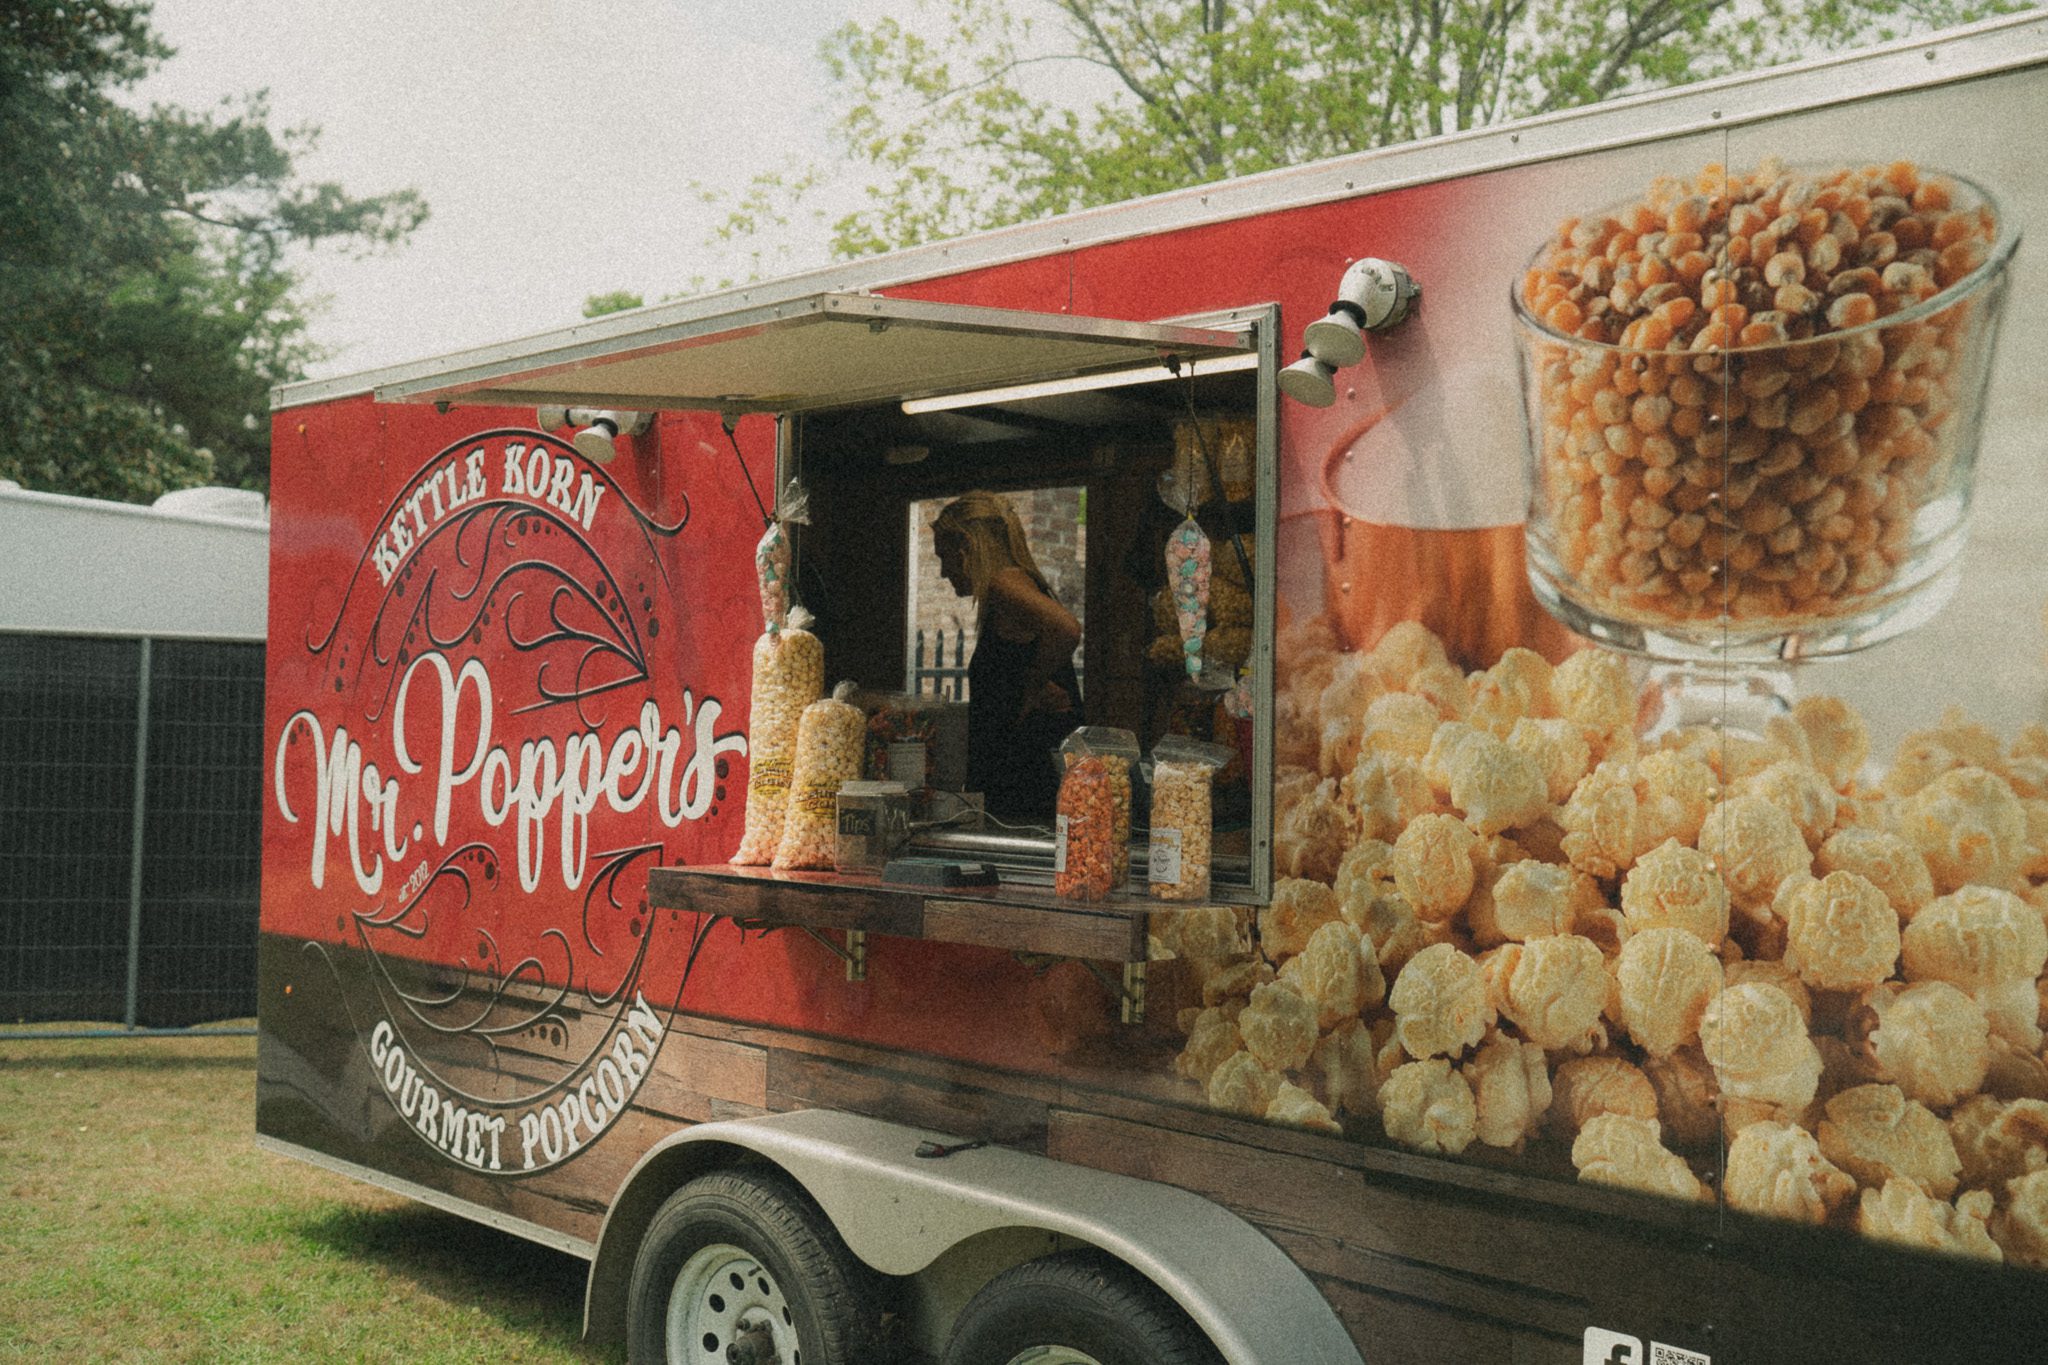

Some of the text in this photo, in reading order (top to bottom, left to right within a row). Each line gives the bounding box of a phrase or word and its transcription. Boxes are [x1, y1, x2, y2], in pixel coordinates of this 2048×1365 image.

[372, 443, 606, 588] KETTLE KORN
[275, 651, 748, 895] Mr. Popper's
[409, 859, 430, 894] 2012
[371, 989, 665, 1170] GOURMET POPCORN
